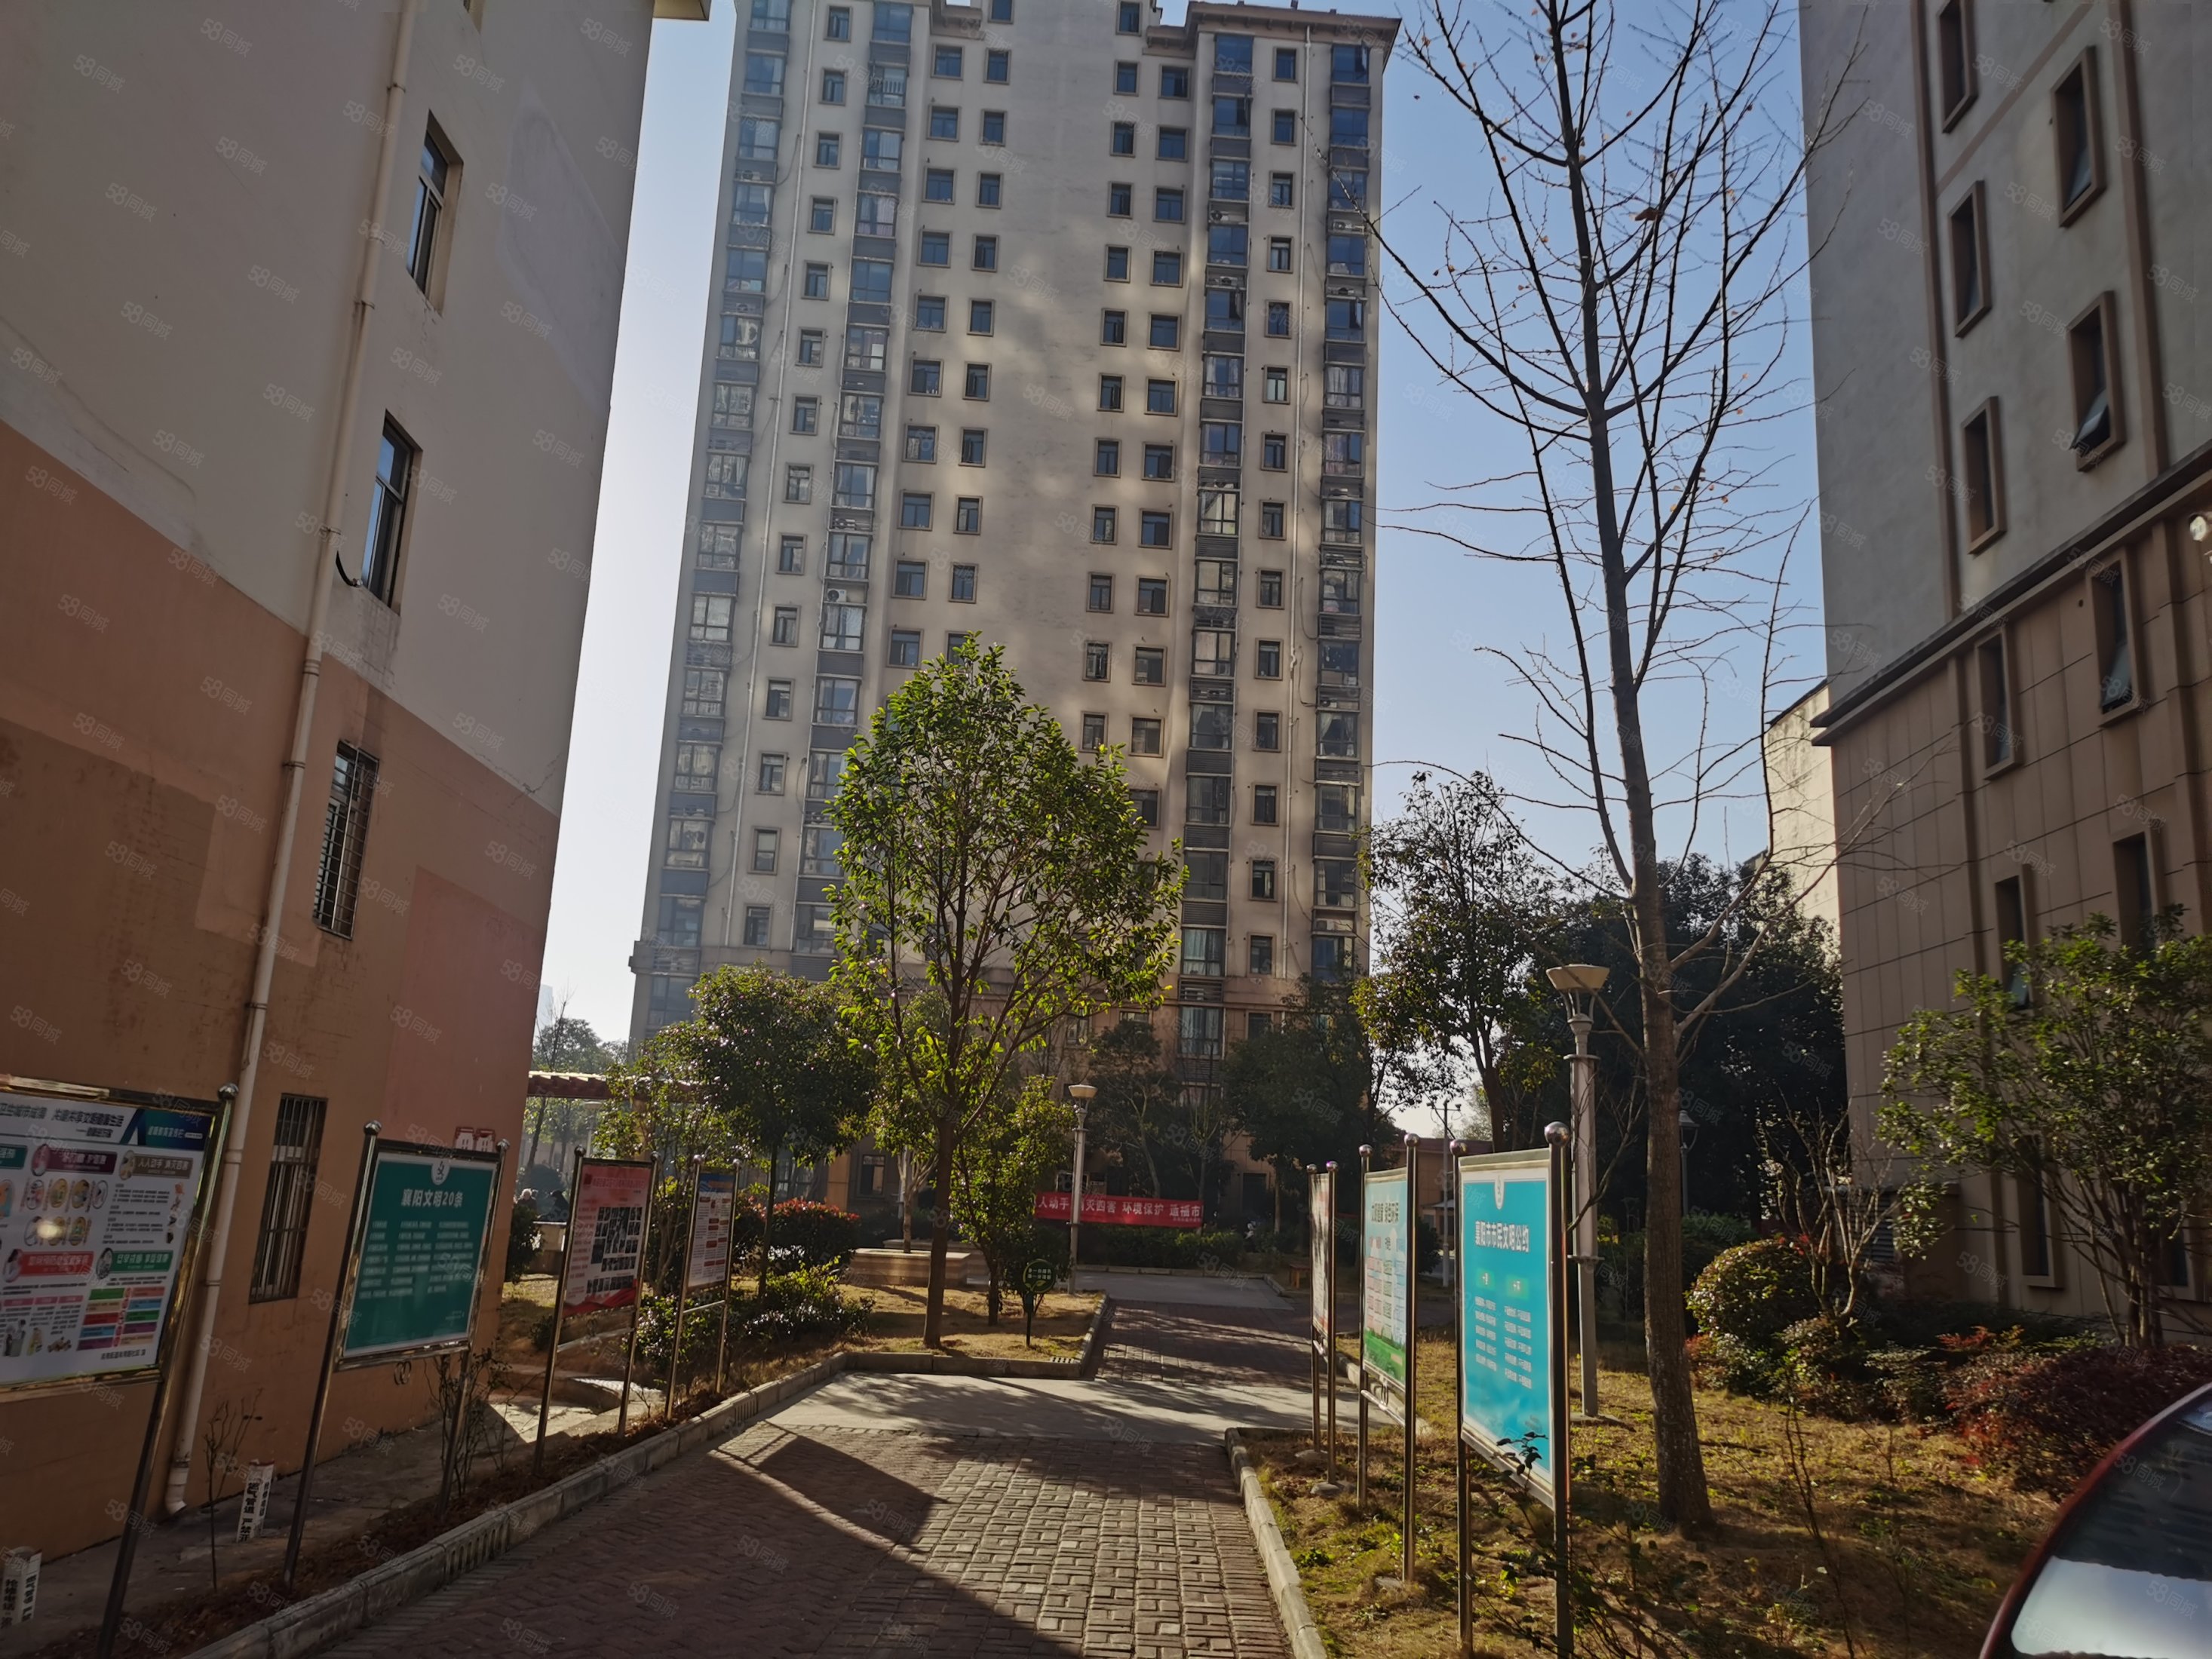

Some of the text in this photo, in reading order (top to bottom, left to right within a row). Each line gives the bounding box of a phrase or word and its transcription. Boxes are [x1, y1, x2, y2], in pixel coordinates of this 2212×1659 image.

[401, 1188, 464, 1208] 襄阳文明20条
[1034, 1197, 1070, 1210] 人动手
[1121, 1201, 1164, 1216] 环境保护
